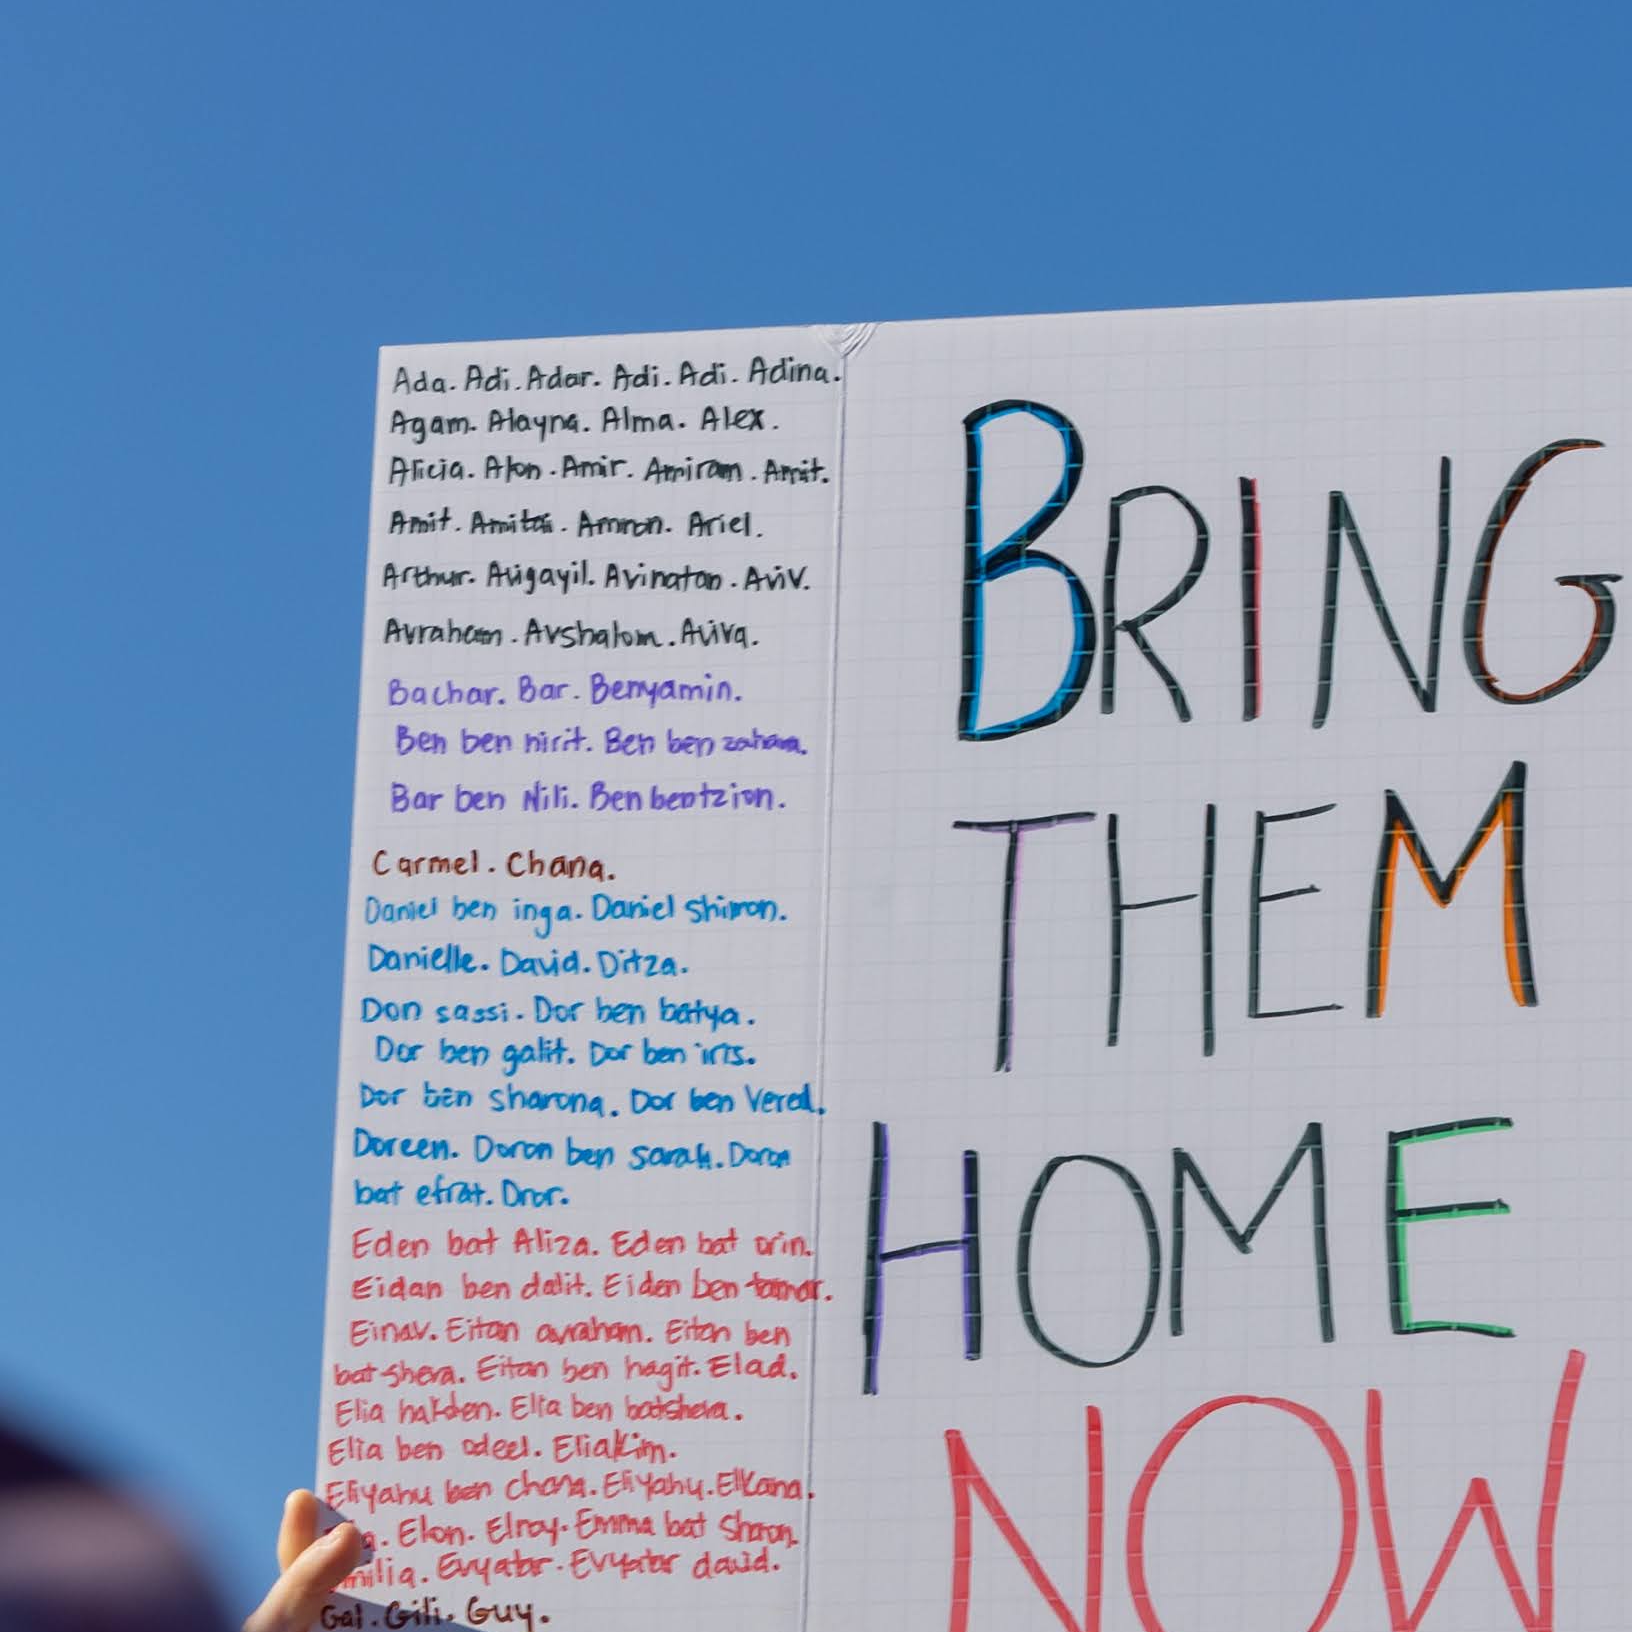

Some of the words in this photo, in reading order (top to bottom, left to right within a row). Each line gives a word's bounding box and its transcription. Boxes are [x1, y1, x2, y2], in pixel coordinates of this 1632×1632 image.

[957, 397, 1623, 743] BRING
[951, 758, 1540, 1073] THEM
[861, 1115, 1520, 1397] HOME
